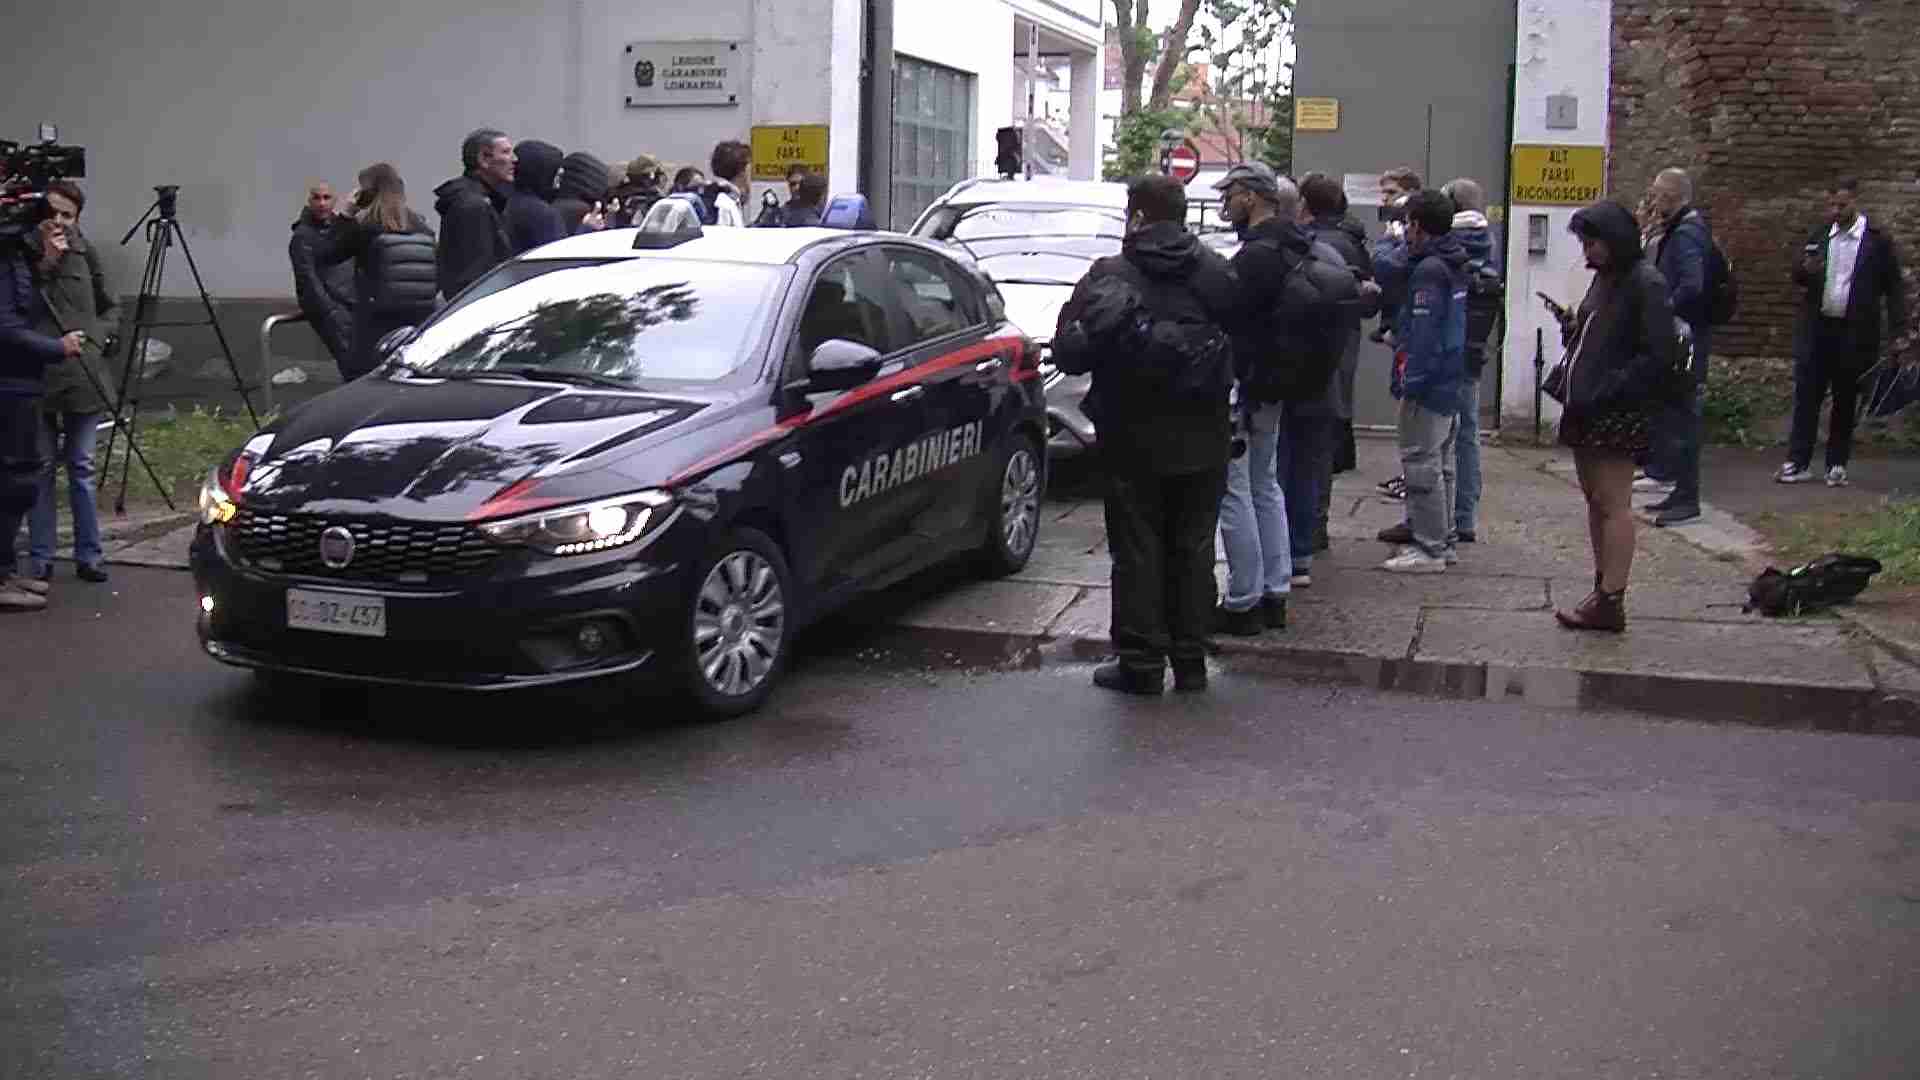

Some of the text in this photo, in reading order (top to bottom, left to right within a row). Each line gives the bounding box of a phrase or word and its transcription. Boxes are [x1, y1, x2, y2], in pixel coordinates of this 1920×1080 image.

[672, 55, 716, 66] LEGIONE
[661, 67, 727, 78] CARABINIERI
[663, 79, 722, 89] LOMBARDIA
[1547, 149, 1569, 162] ALT
[1540, 167, 1576, 181] FARSI
[839, 419, 983, 508] CARABINIERI
